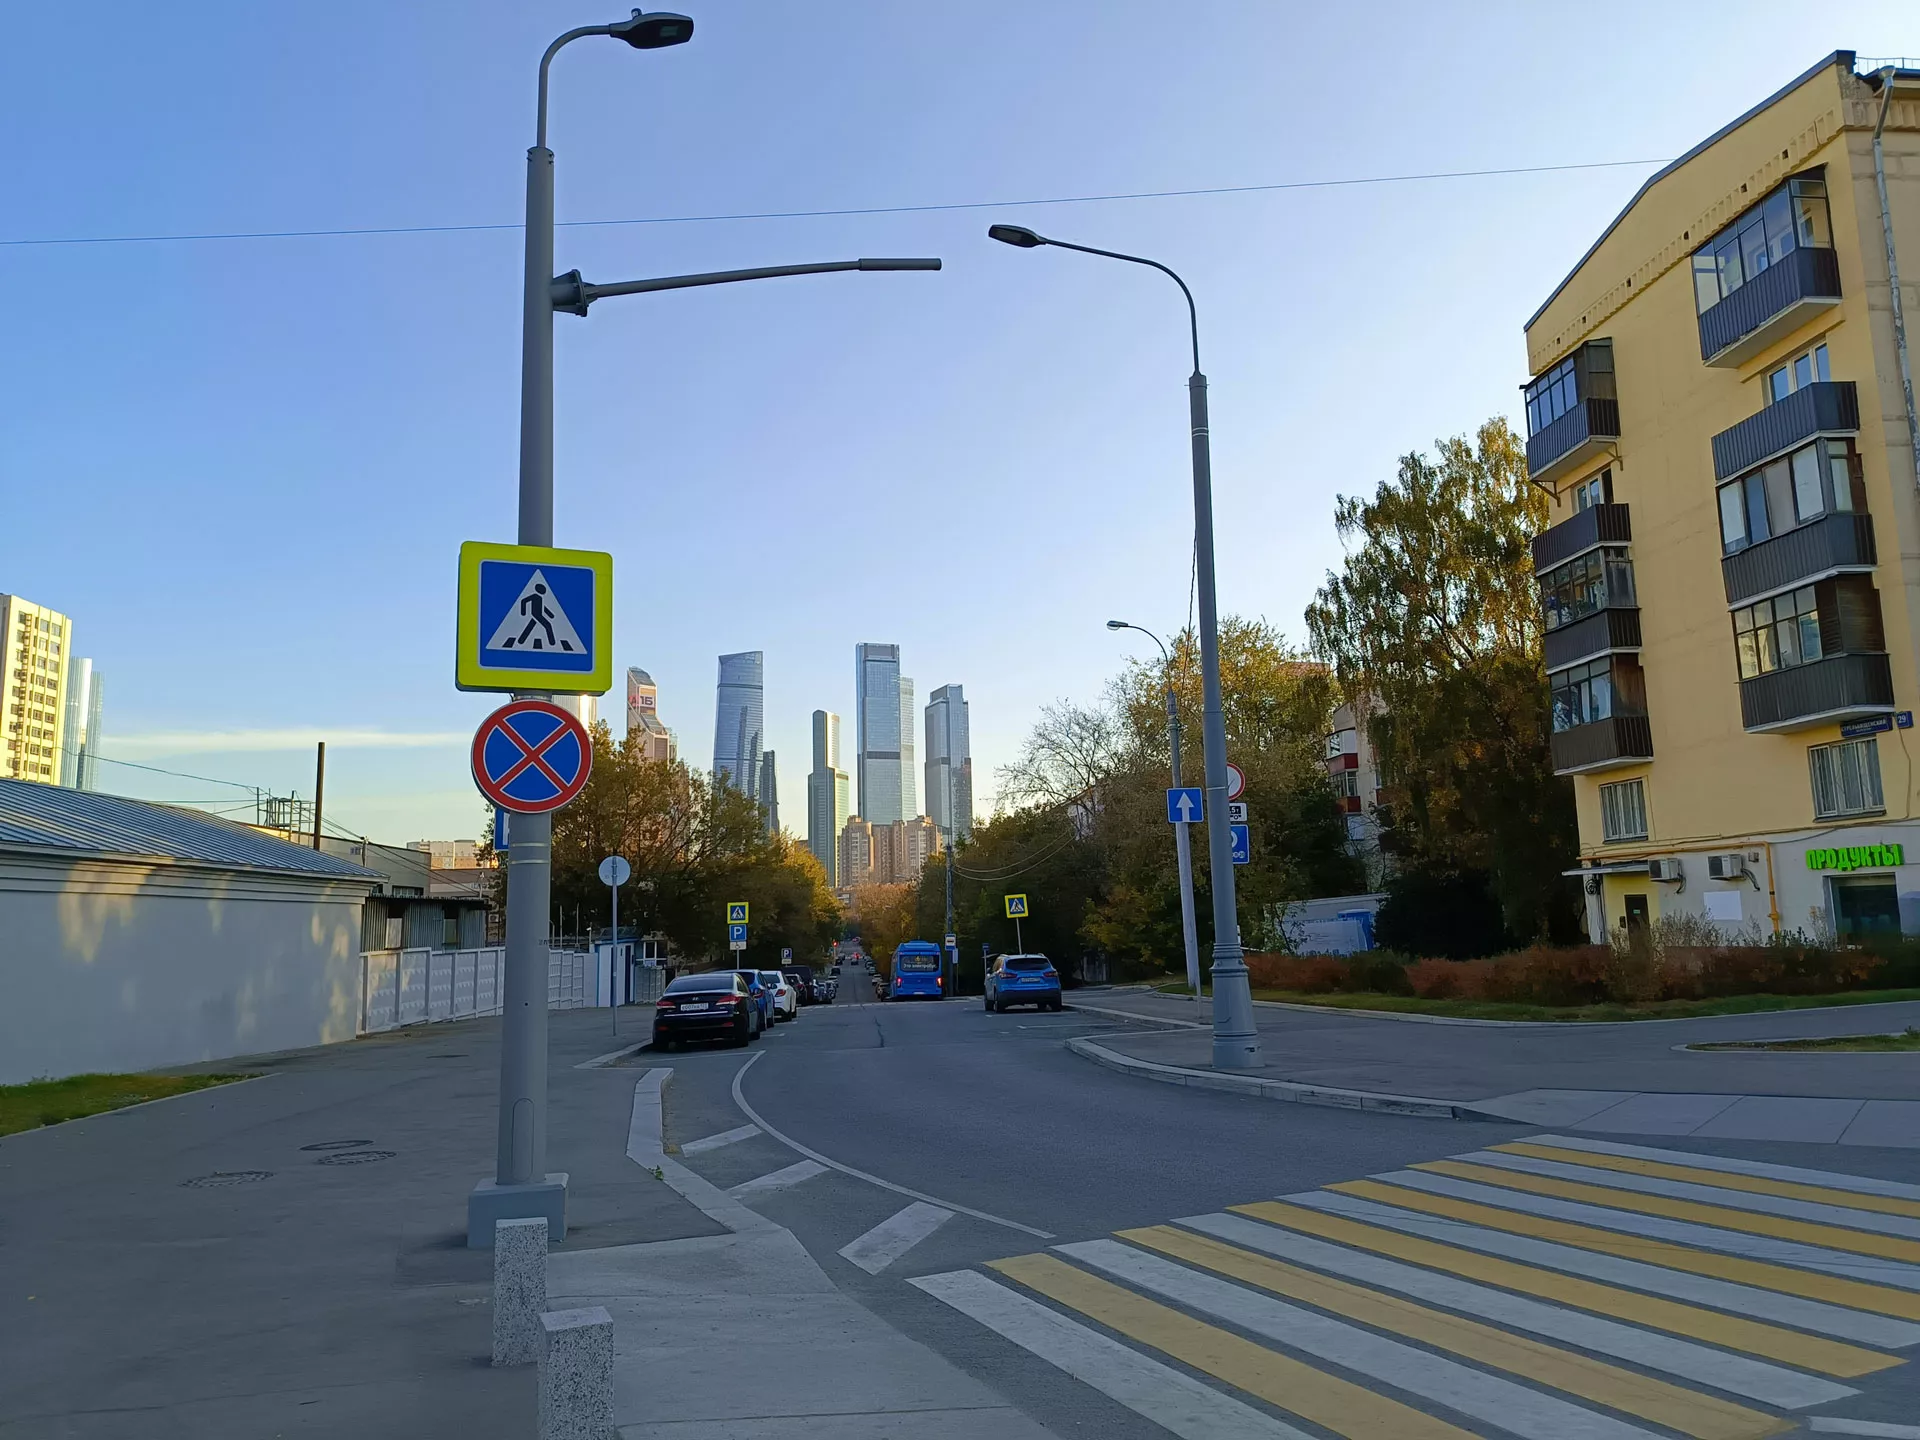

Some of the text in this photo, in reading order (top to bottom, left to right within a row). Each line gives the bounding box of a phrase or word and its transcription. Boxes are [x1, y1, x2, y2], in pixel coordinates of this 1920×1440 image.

[1897, 715, 1907, 723] 29
[1805, 843, 1902, 872] ПРОДУКТЫ
[733, 926, 743, 939] P
[783, 949, 790, 958] P
